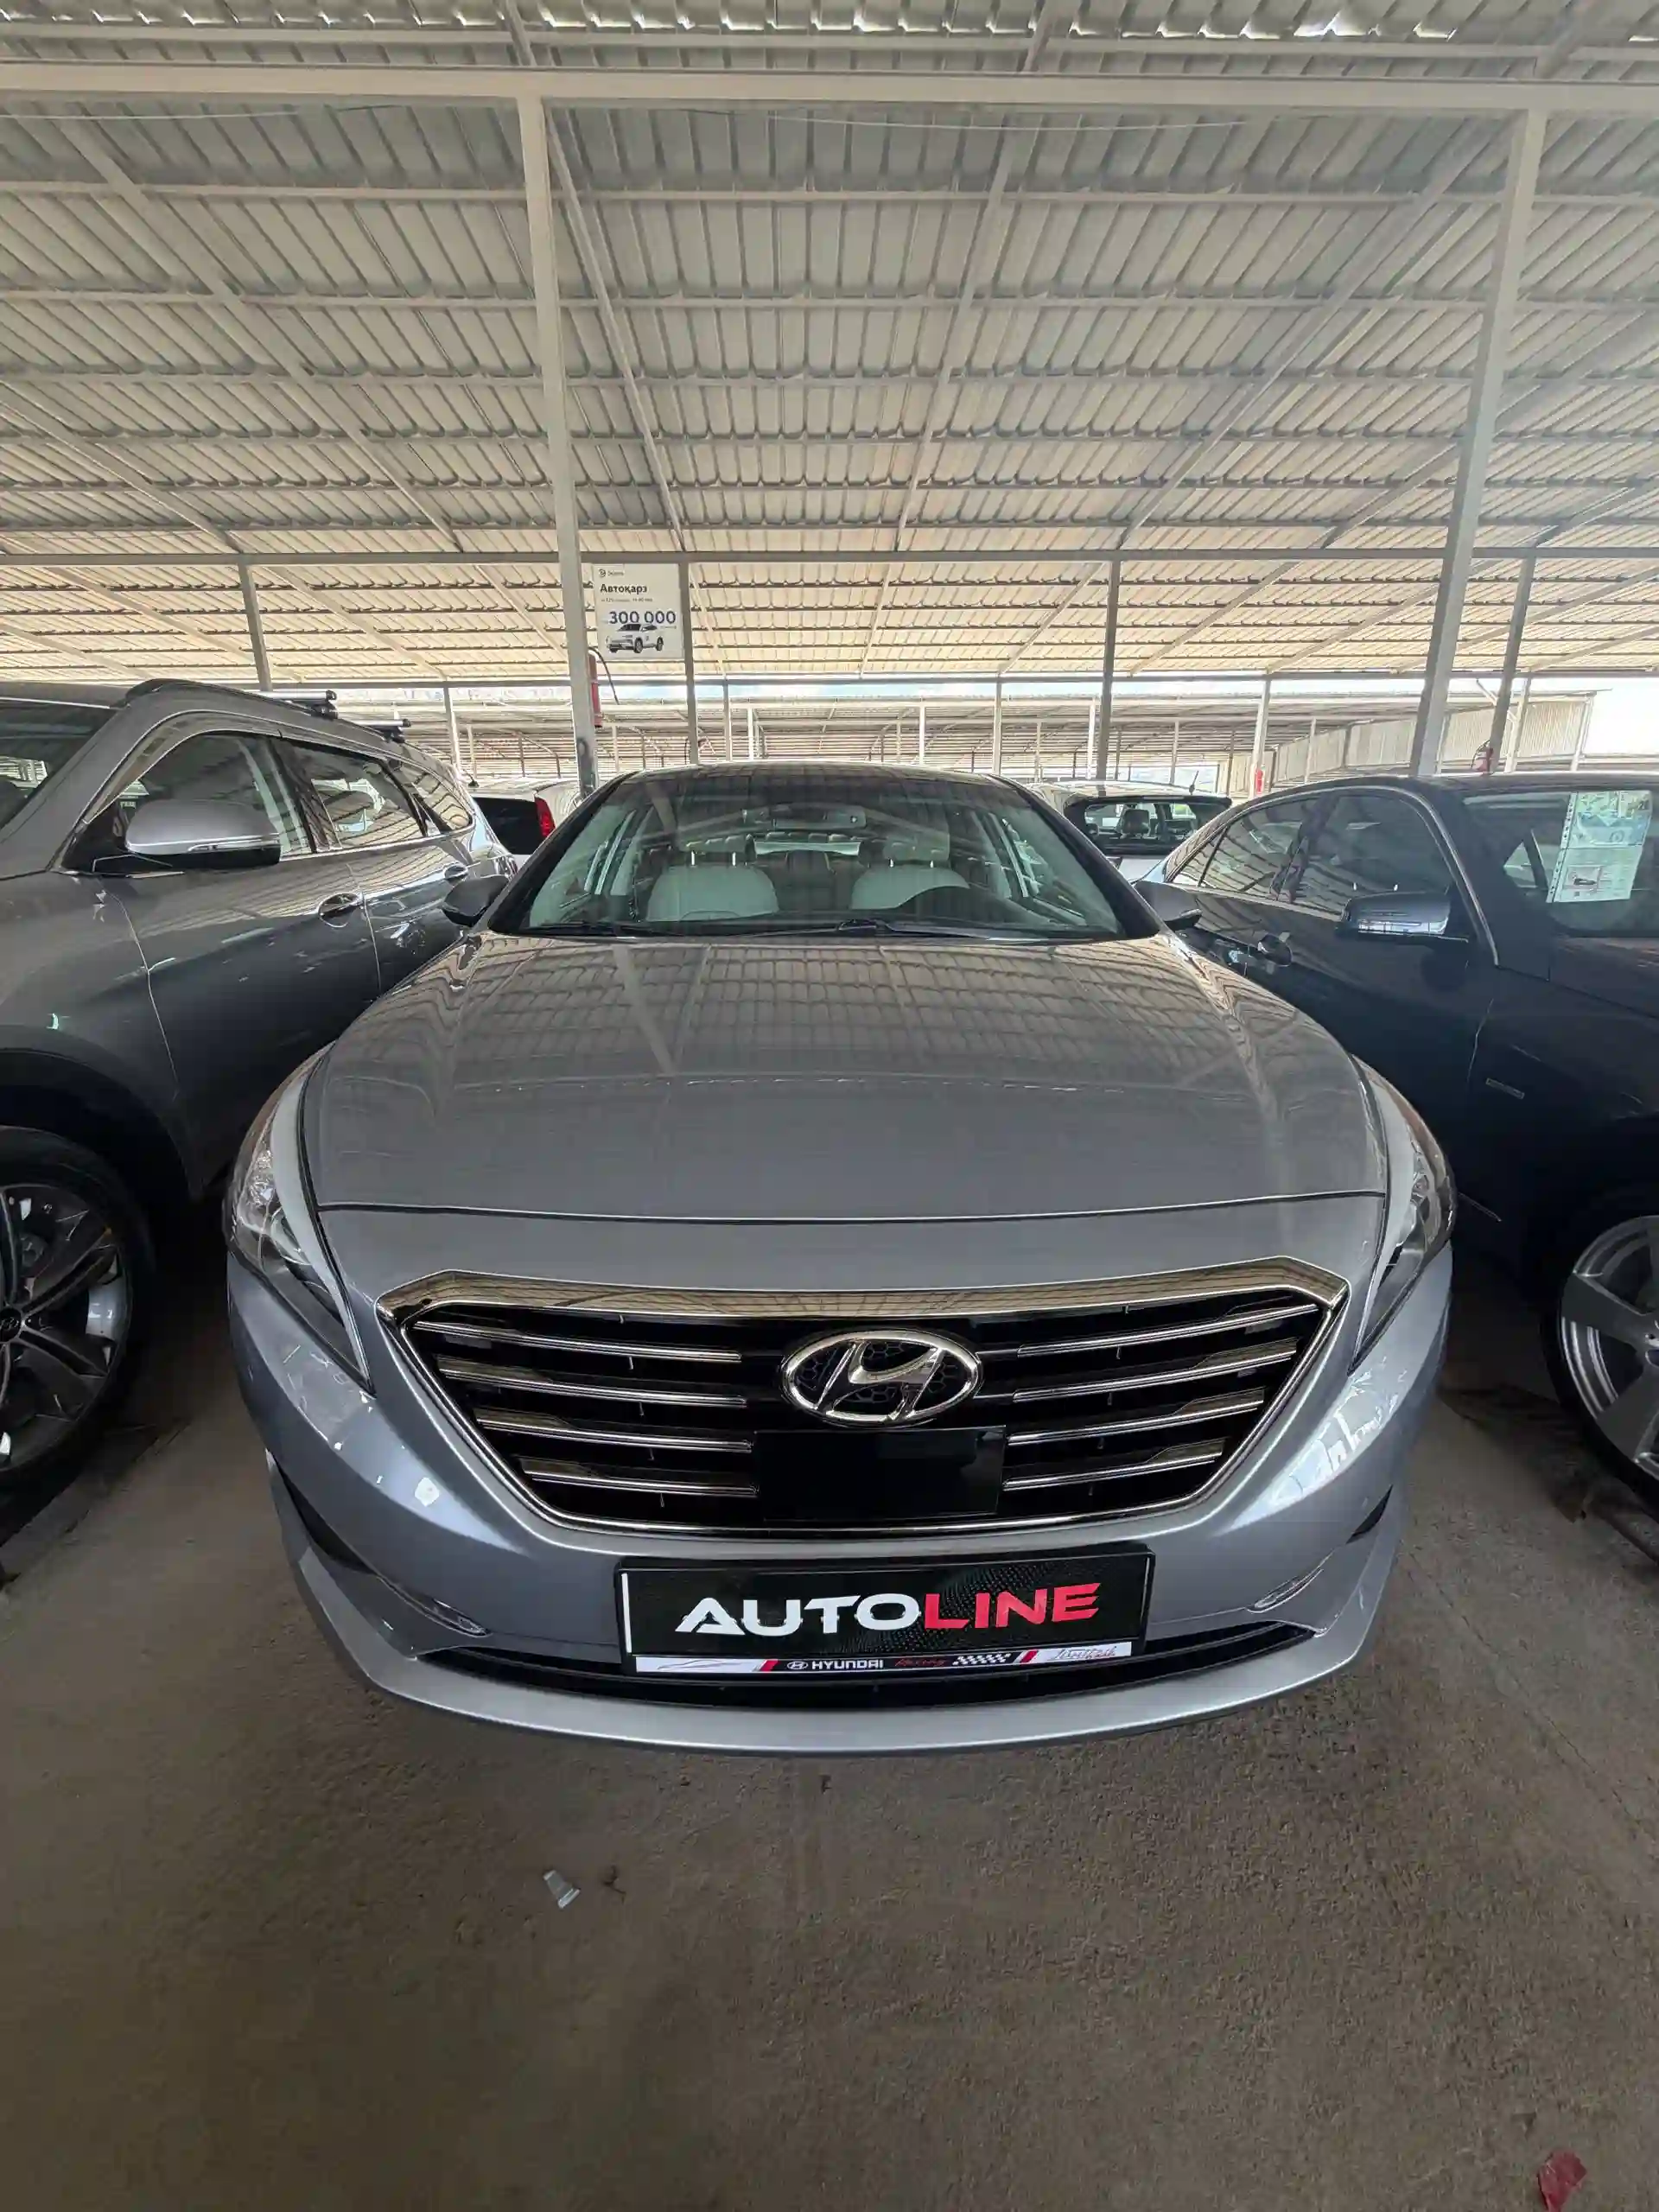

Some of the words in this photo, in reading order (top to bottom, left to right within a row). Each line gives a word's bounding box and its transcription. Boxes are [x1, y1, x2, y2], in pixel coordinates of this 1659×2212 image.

[600, 583, 647, 594] Автоқарз
[608, 611, 640, 624] 300
[644, 611, 676, 624] 000
[673, 1582, 1102, 1637] AUTOLINE
[811, 1659, 883, 1670] HYUNDAI
